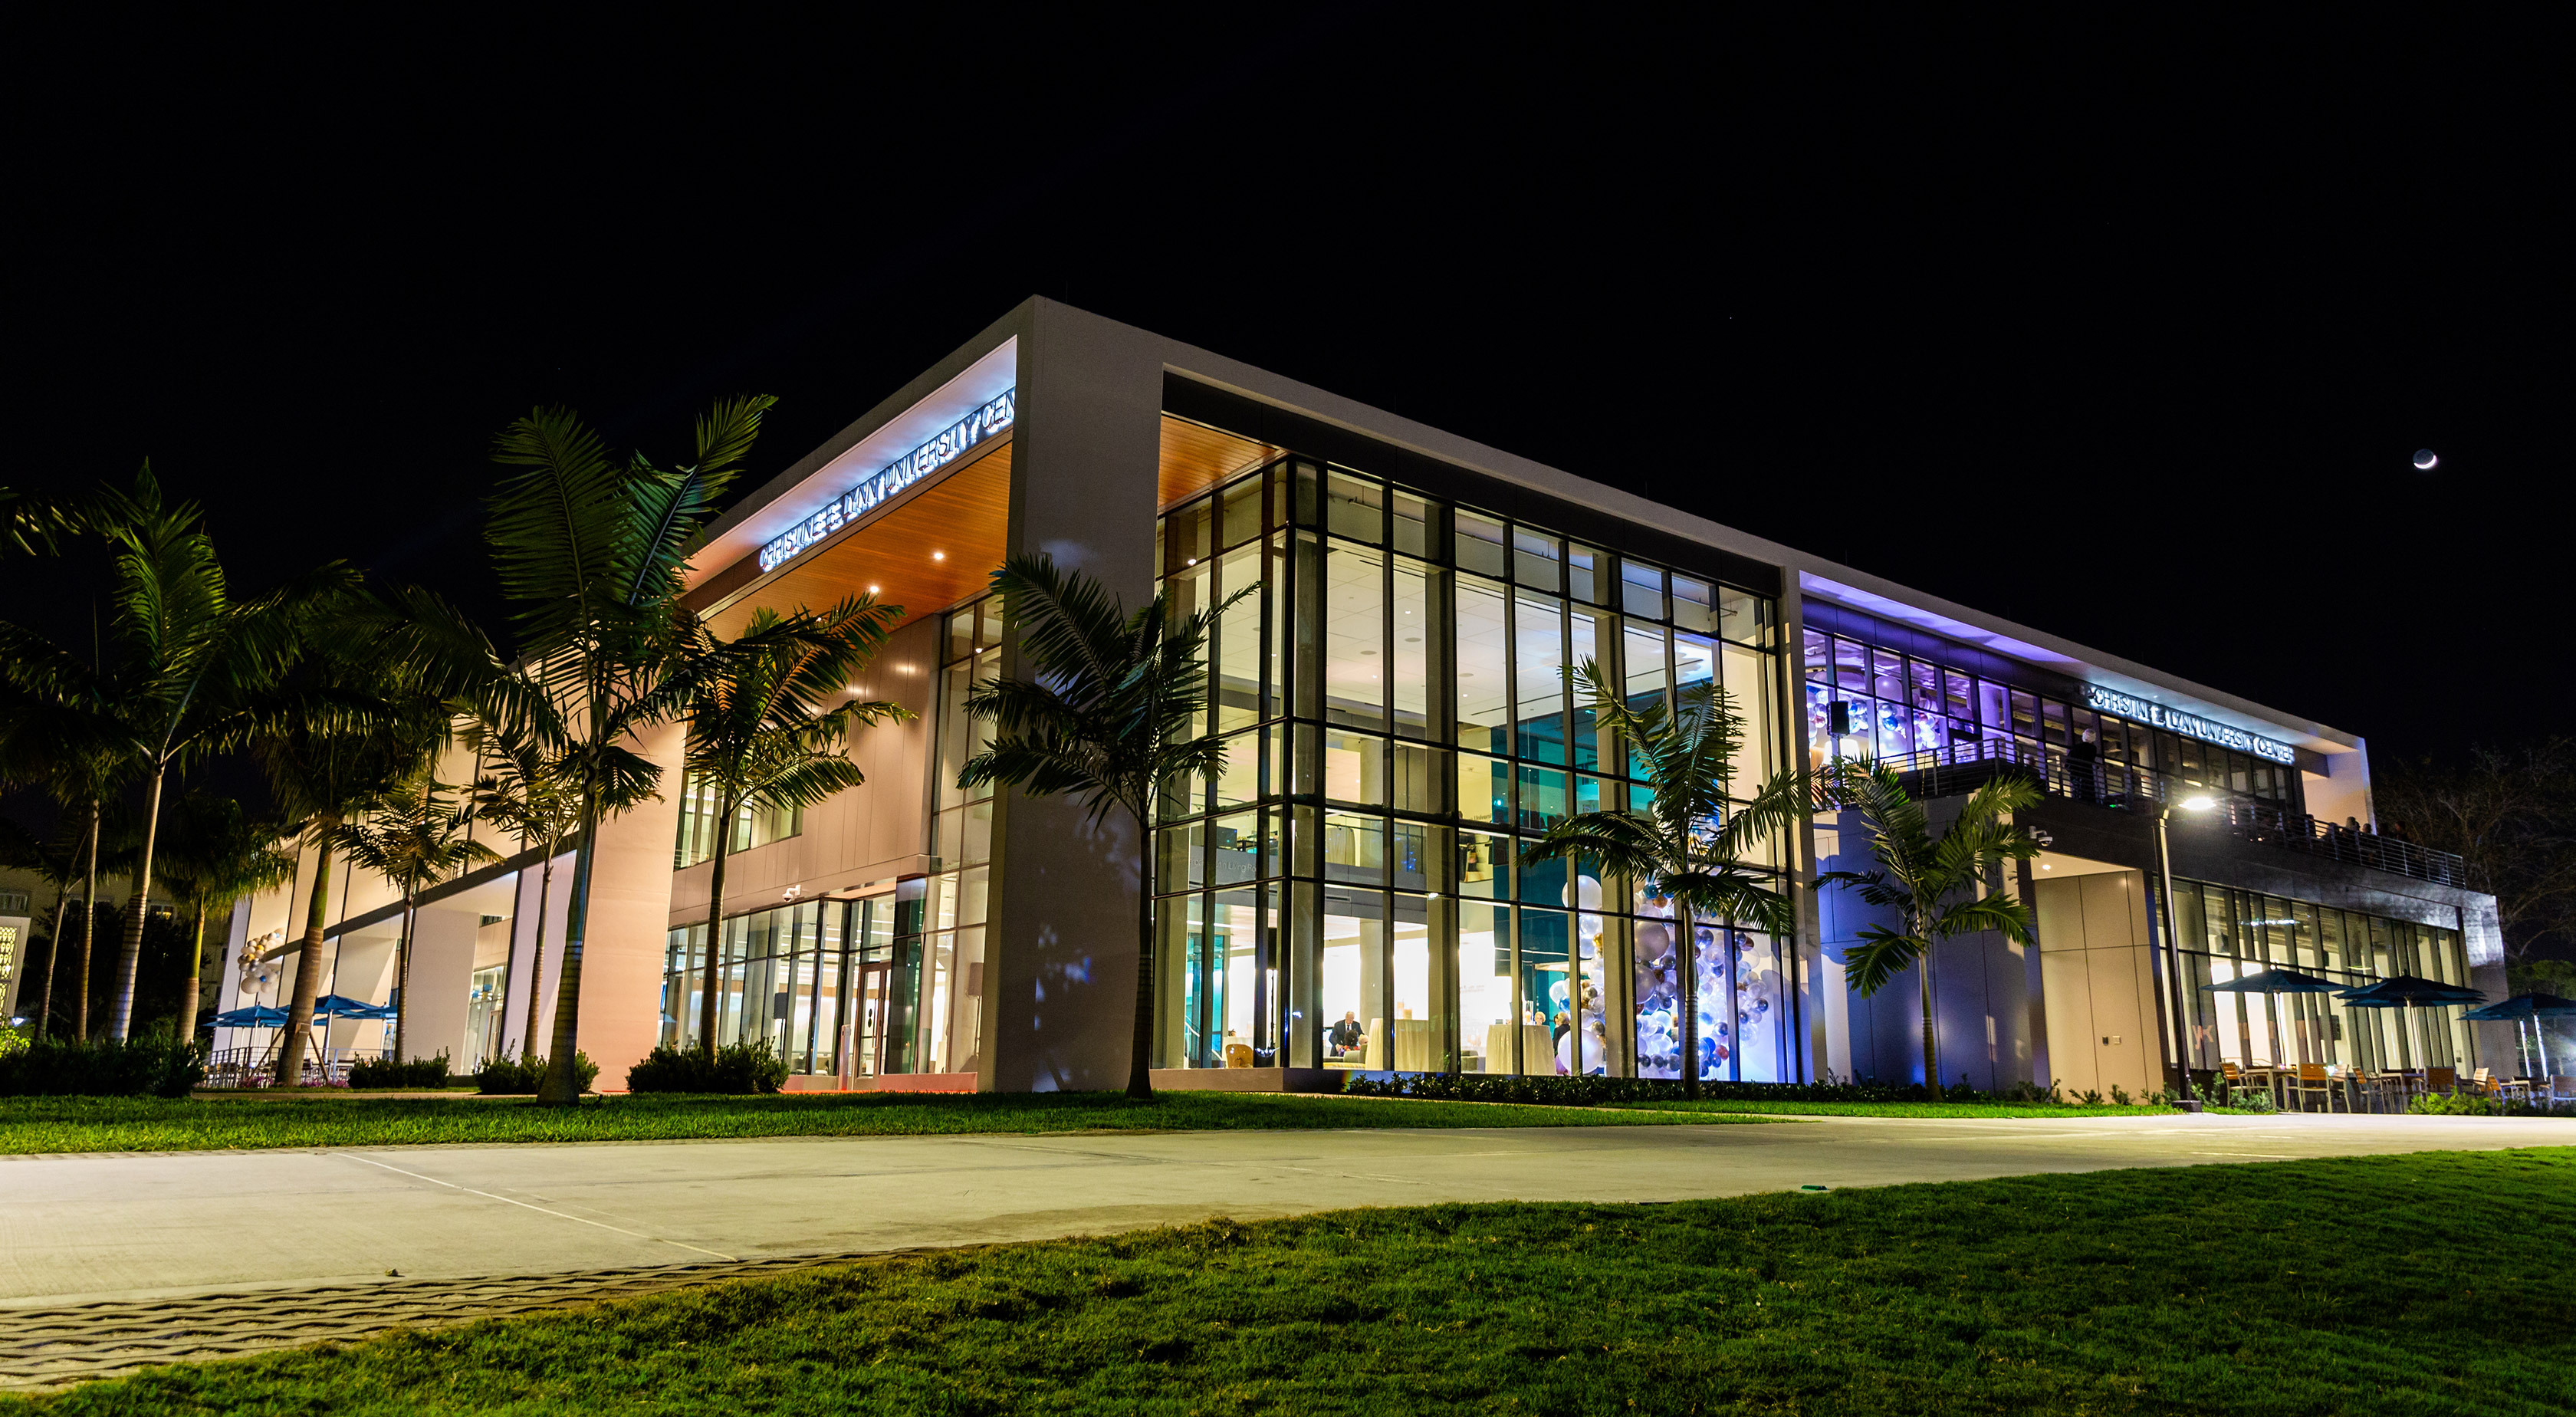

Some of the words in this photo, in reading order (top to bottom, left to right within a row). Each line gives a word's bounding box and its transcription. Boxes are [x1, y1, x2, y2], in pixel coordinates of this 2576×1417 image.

[759, 511, 826, 571] CHRISTINE
[843, 478, 881, 520] LYNN
[885, 413, 979, 493] UNIVERSITY
[981, 388, 1015, 432] CEN
[2165, 710, 2196, 735] LYNN
[2196, 718, 2253, 751] UNIVERSITY
[2253, 736, 2294, 765] CENTER
